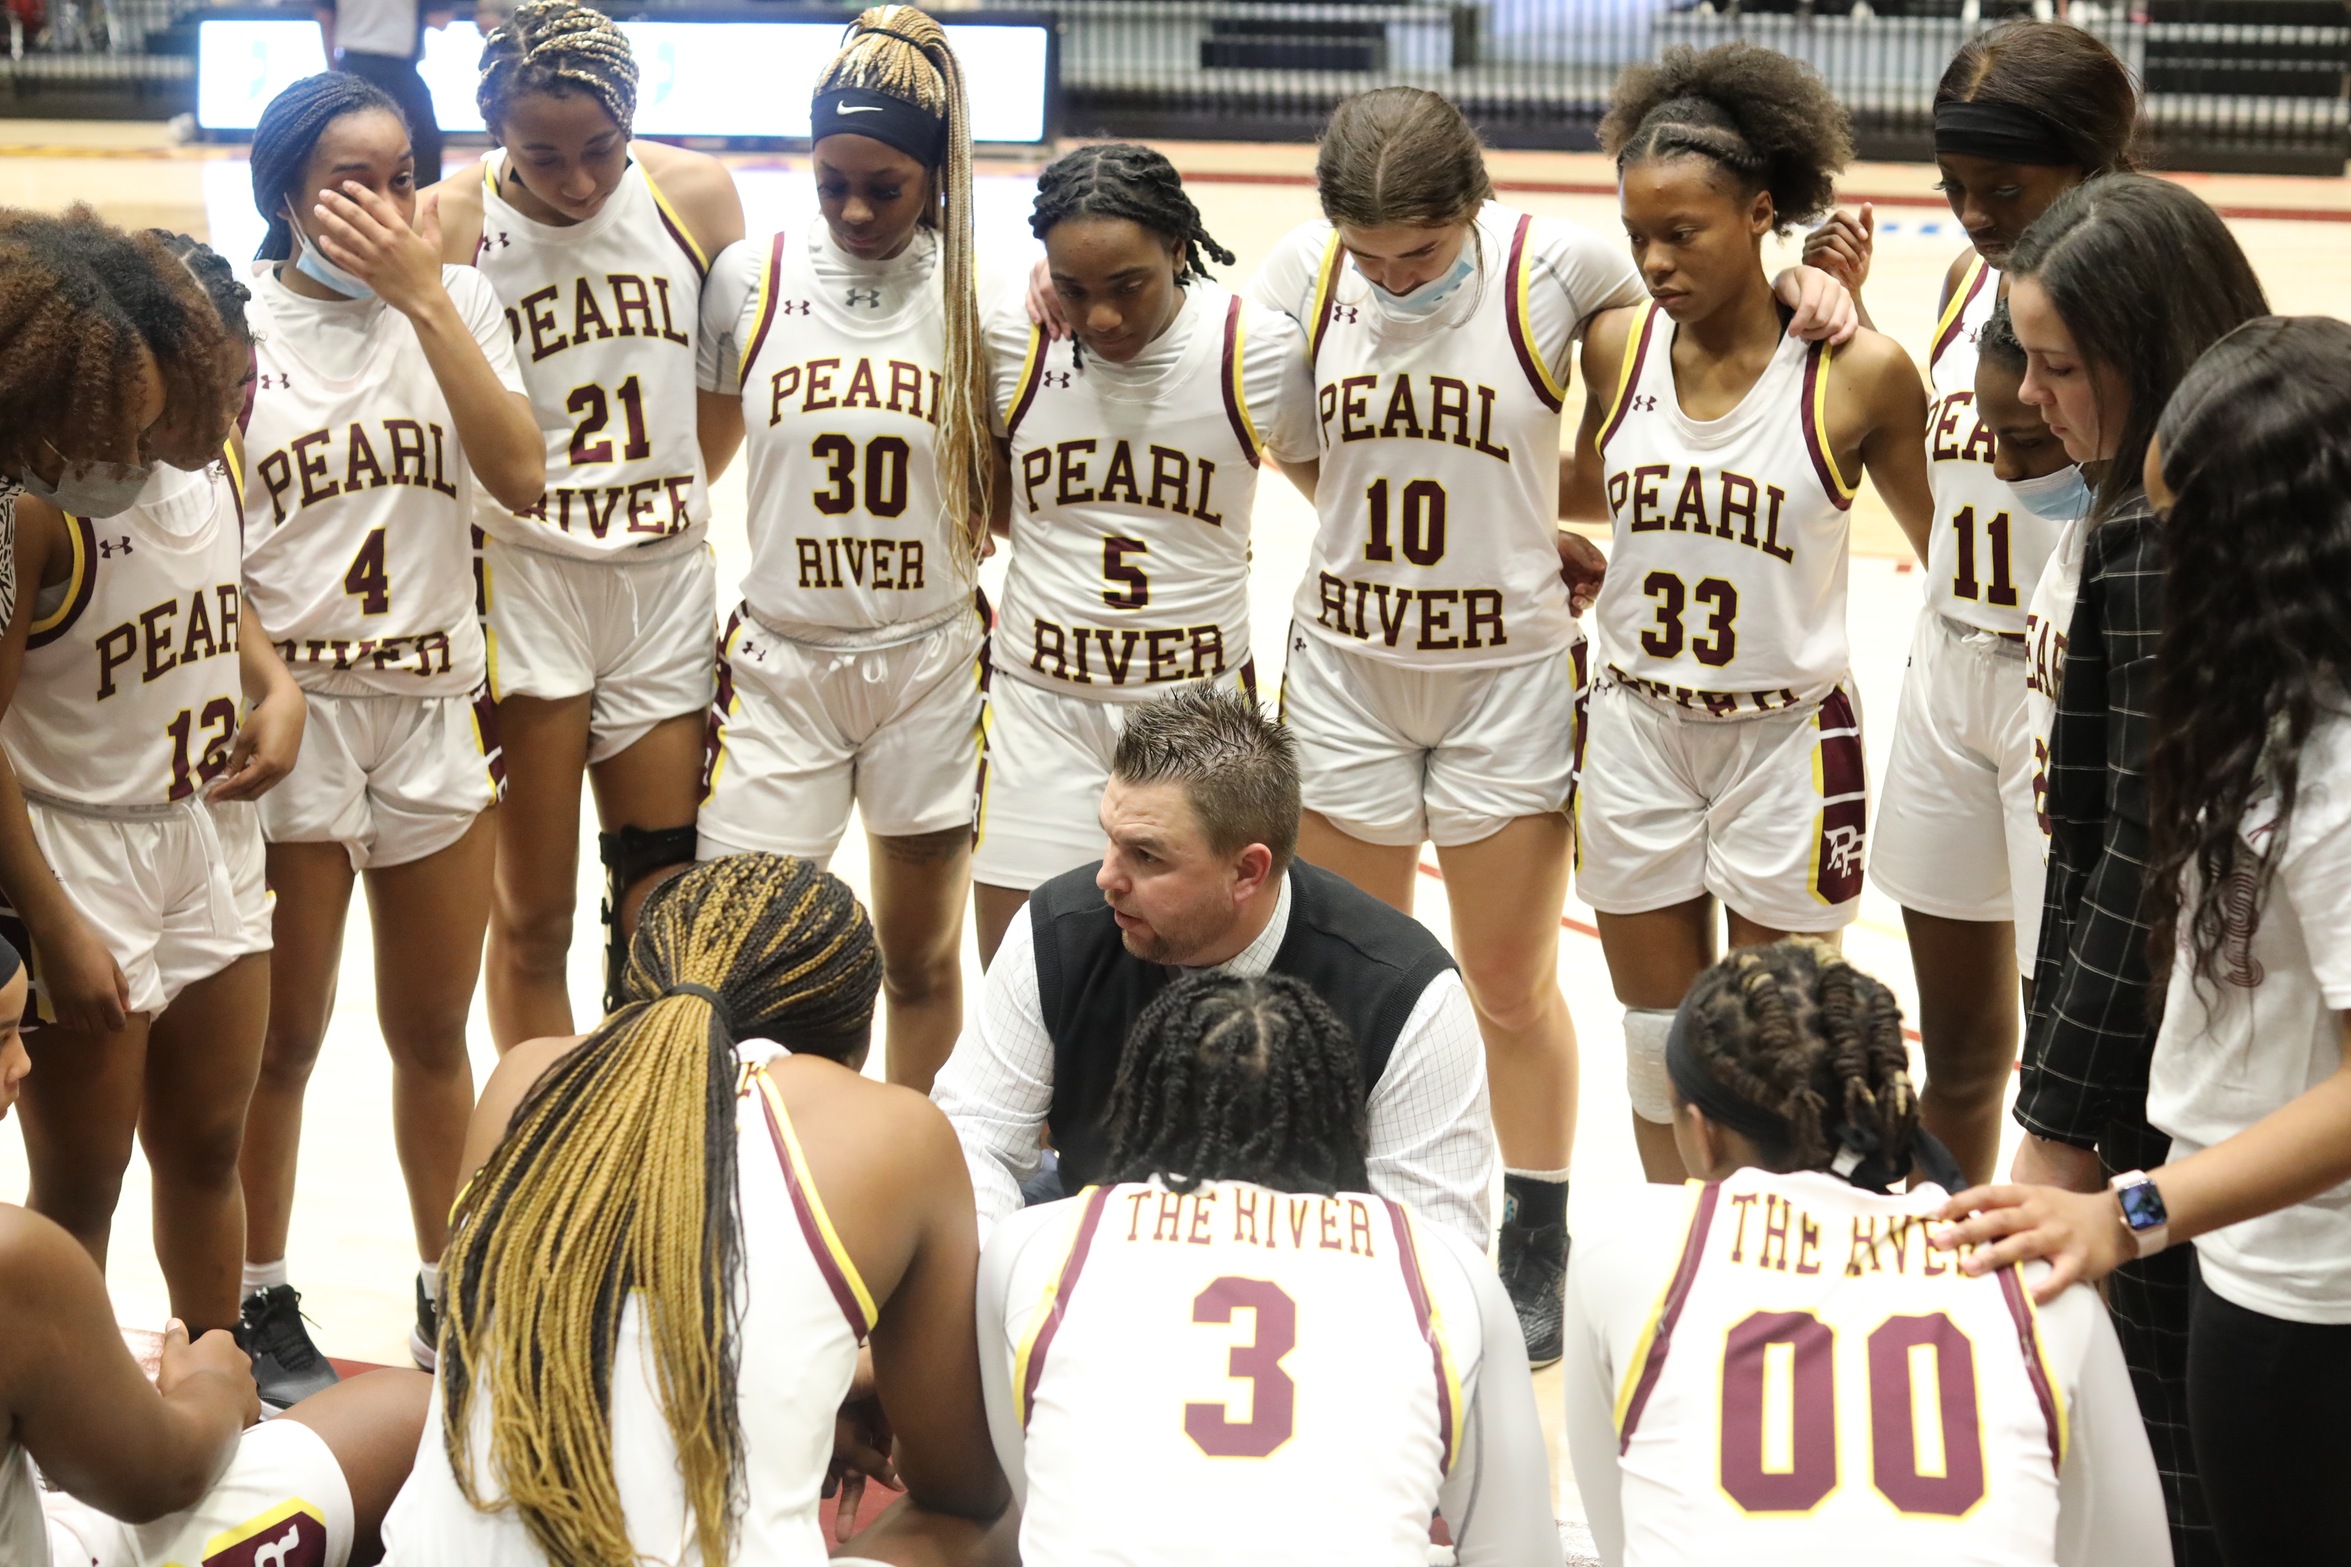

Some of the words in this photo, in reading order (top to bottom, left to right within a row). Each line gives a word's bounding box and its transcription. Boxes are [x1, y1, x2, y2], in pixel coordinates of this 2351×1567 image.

[511, 273, 691, 364] PEARL
[565, 374, 651, 467] 21
[1318, 372, 1508, 462] PEARL
[257, 419, 458, 526] PEARL
[809, 432, 911, 519] 30
[1021, 438, 1223, 528] PEARL
[1606, 464, 1794, 564] PEARL
[795, 537, 925, 592] RIVER
[1364, 478, 1446, 568] 10
[1952, 503, 2019, 608] 11
[345, 527, 390, 616] 4
[1101, 536, 1150, 611] 5
[1316, 571, 1506, 652] RIVER
[95, 583, 242, 702] PEAR
[1028, 618, 1227, 686] RIVER
[1640, 570, 1739, 668] 33
[1126, 1189, 1218, 1247] THE
[1234, 1187, 1376, 1259] RIVER
[1730, 1192, 1822, 1276] THE
[1183, 1275, 1297, 1458] 3
[1718, 1308, 1986, 1518] 00
